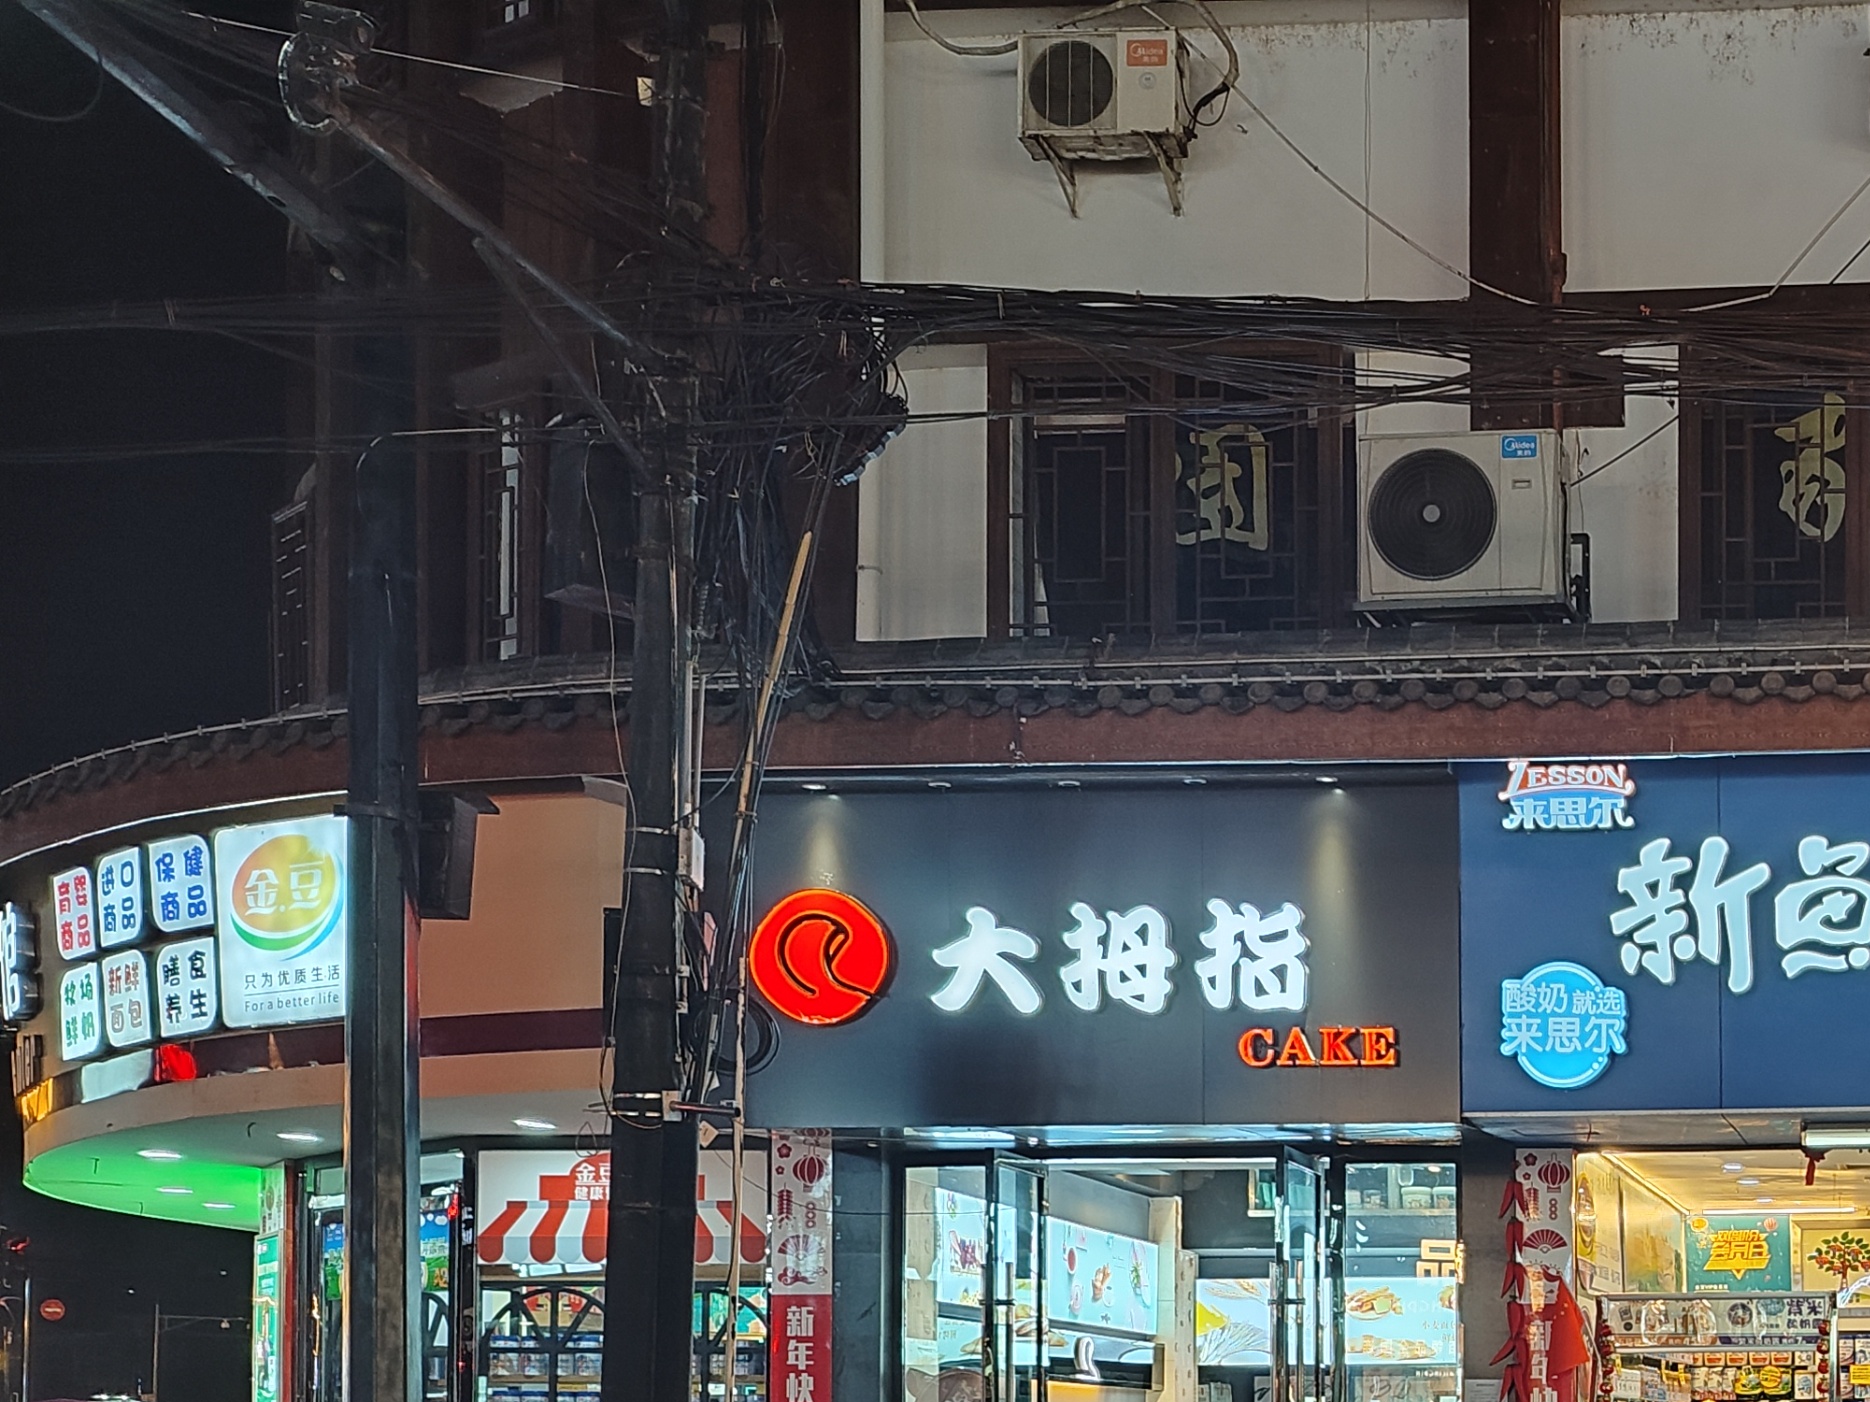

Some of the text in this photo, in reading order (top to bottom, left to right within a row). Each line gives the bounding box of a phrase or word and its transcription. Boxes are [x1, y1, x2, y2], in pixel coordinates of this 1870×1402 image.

[1503, 797, 1635, 829] 来思尔
[101, 860, 136, 896] 进口
[155, 846, 204, 883] 保健
[57, 874, 89, 914] 育婴
[161, 884, 208, 922] 商品
[60, 914, 91, 952] 商品
[104, 897, 137, 933] 商品
[163, 950, 207, 987] 膳食
[931, 899, 1313, 1015] 大拇指
[64, 973, 94, 1005] 牧场
[108, 962, 140, 996] 新鲜
[244, 964, 341, 989] 只为优质生活
[111, 999, 143, 1033] 面包
[165, 988, 209, 1025] 养生
[244, 998, 266, 1013] For
[276, 994, 316, 1010] better
[318, 991, 340, 1006] life
[66, 1009, 96, 1046] 鲜奶
[1503, 1015, 1622, 1054] 来思尔
[1238, 1026, 1398, 1068] CAKE
